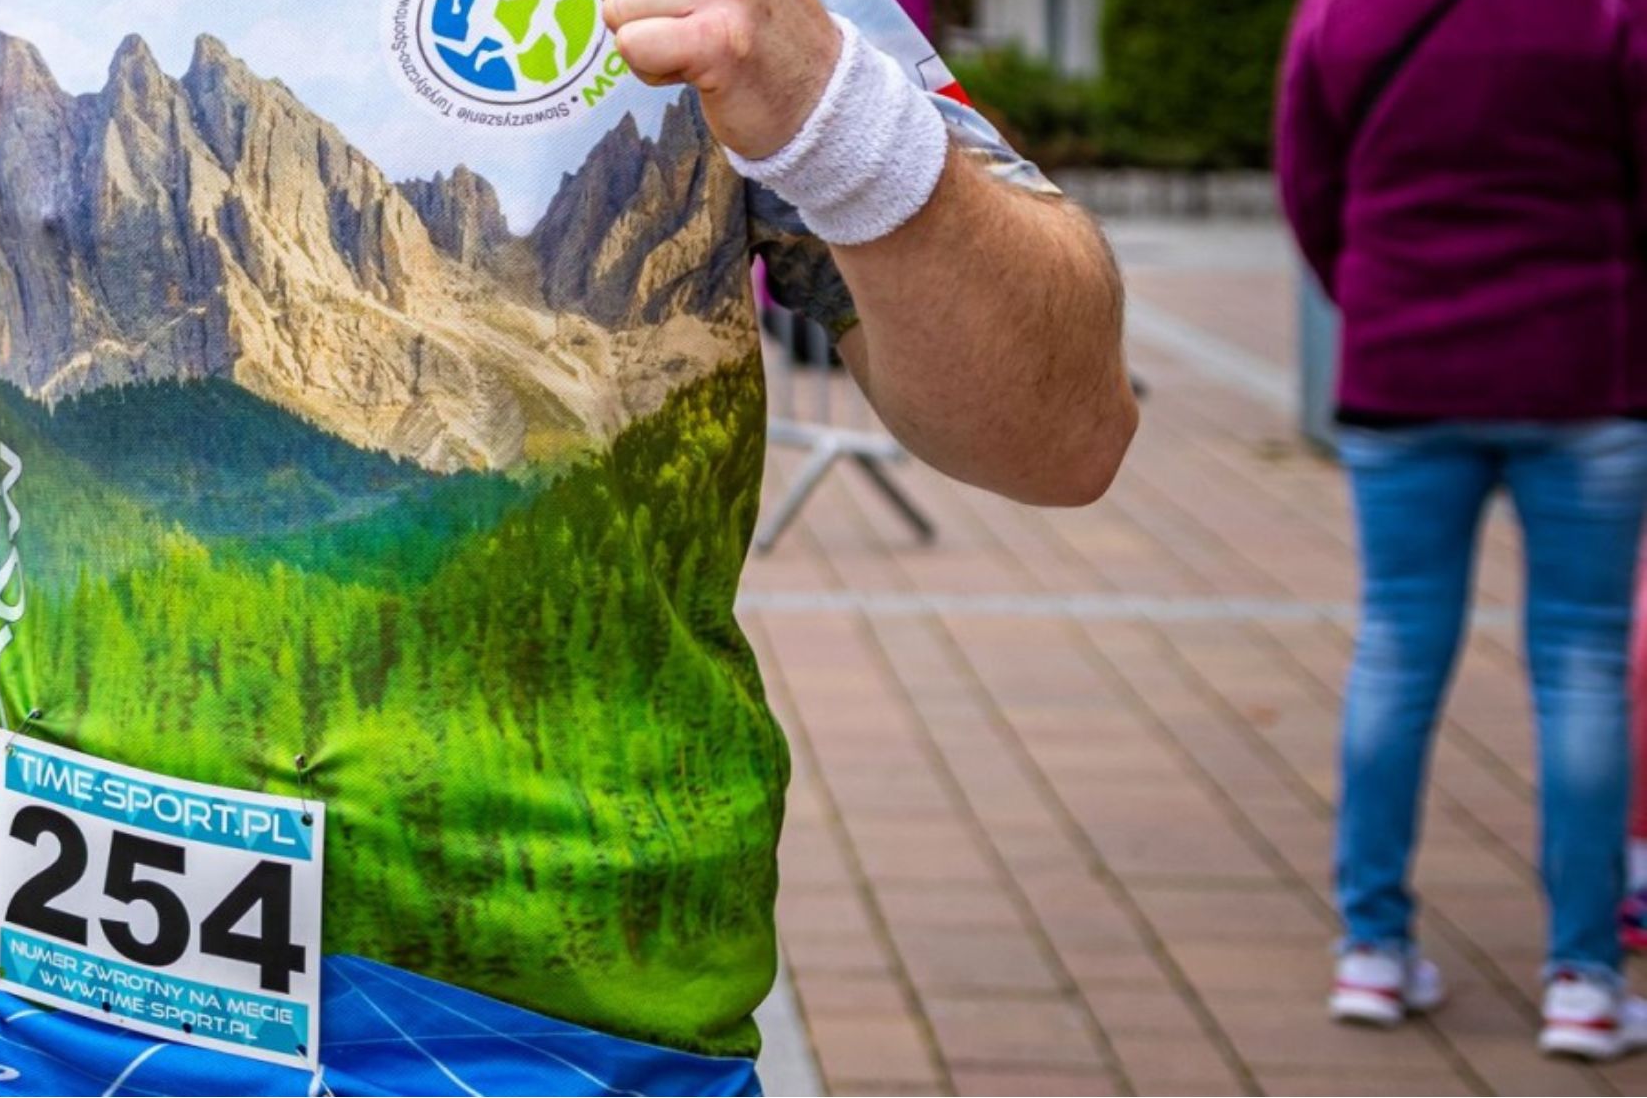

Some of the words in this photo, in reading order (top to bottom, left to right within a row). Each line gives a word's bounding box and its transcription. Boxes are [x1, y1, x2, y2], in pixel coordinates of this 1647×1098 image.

[457, 101, 570, 126] Stowarzyszenie
[17, 754, 295, 845] TIME-SPORT.PL
[5, 805, 307, 995] 254
[10, 940, 78, 973] NUMER
[82, 958, 185, 1000] ZWROTNY
[189, 989, 221, 1011] NA
[226, 998, 294, 1025] MECIE
[39, 968, 258, 1040] WWW.TIME-SPORT.PL
